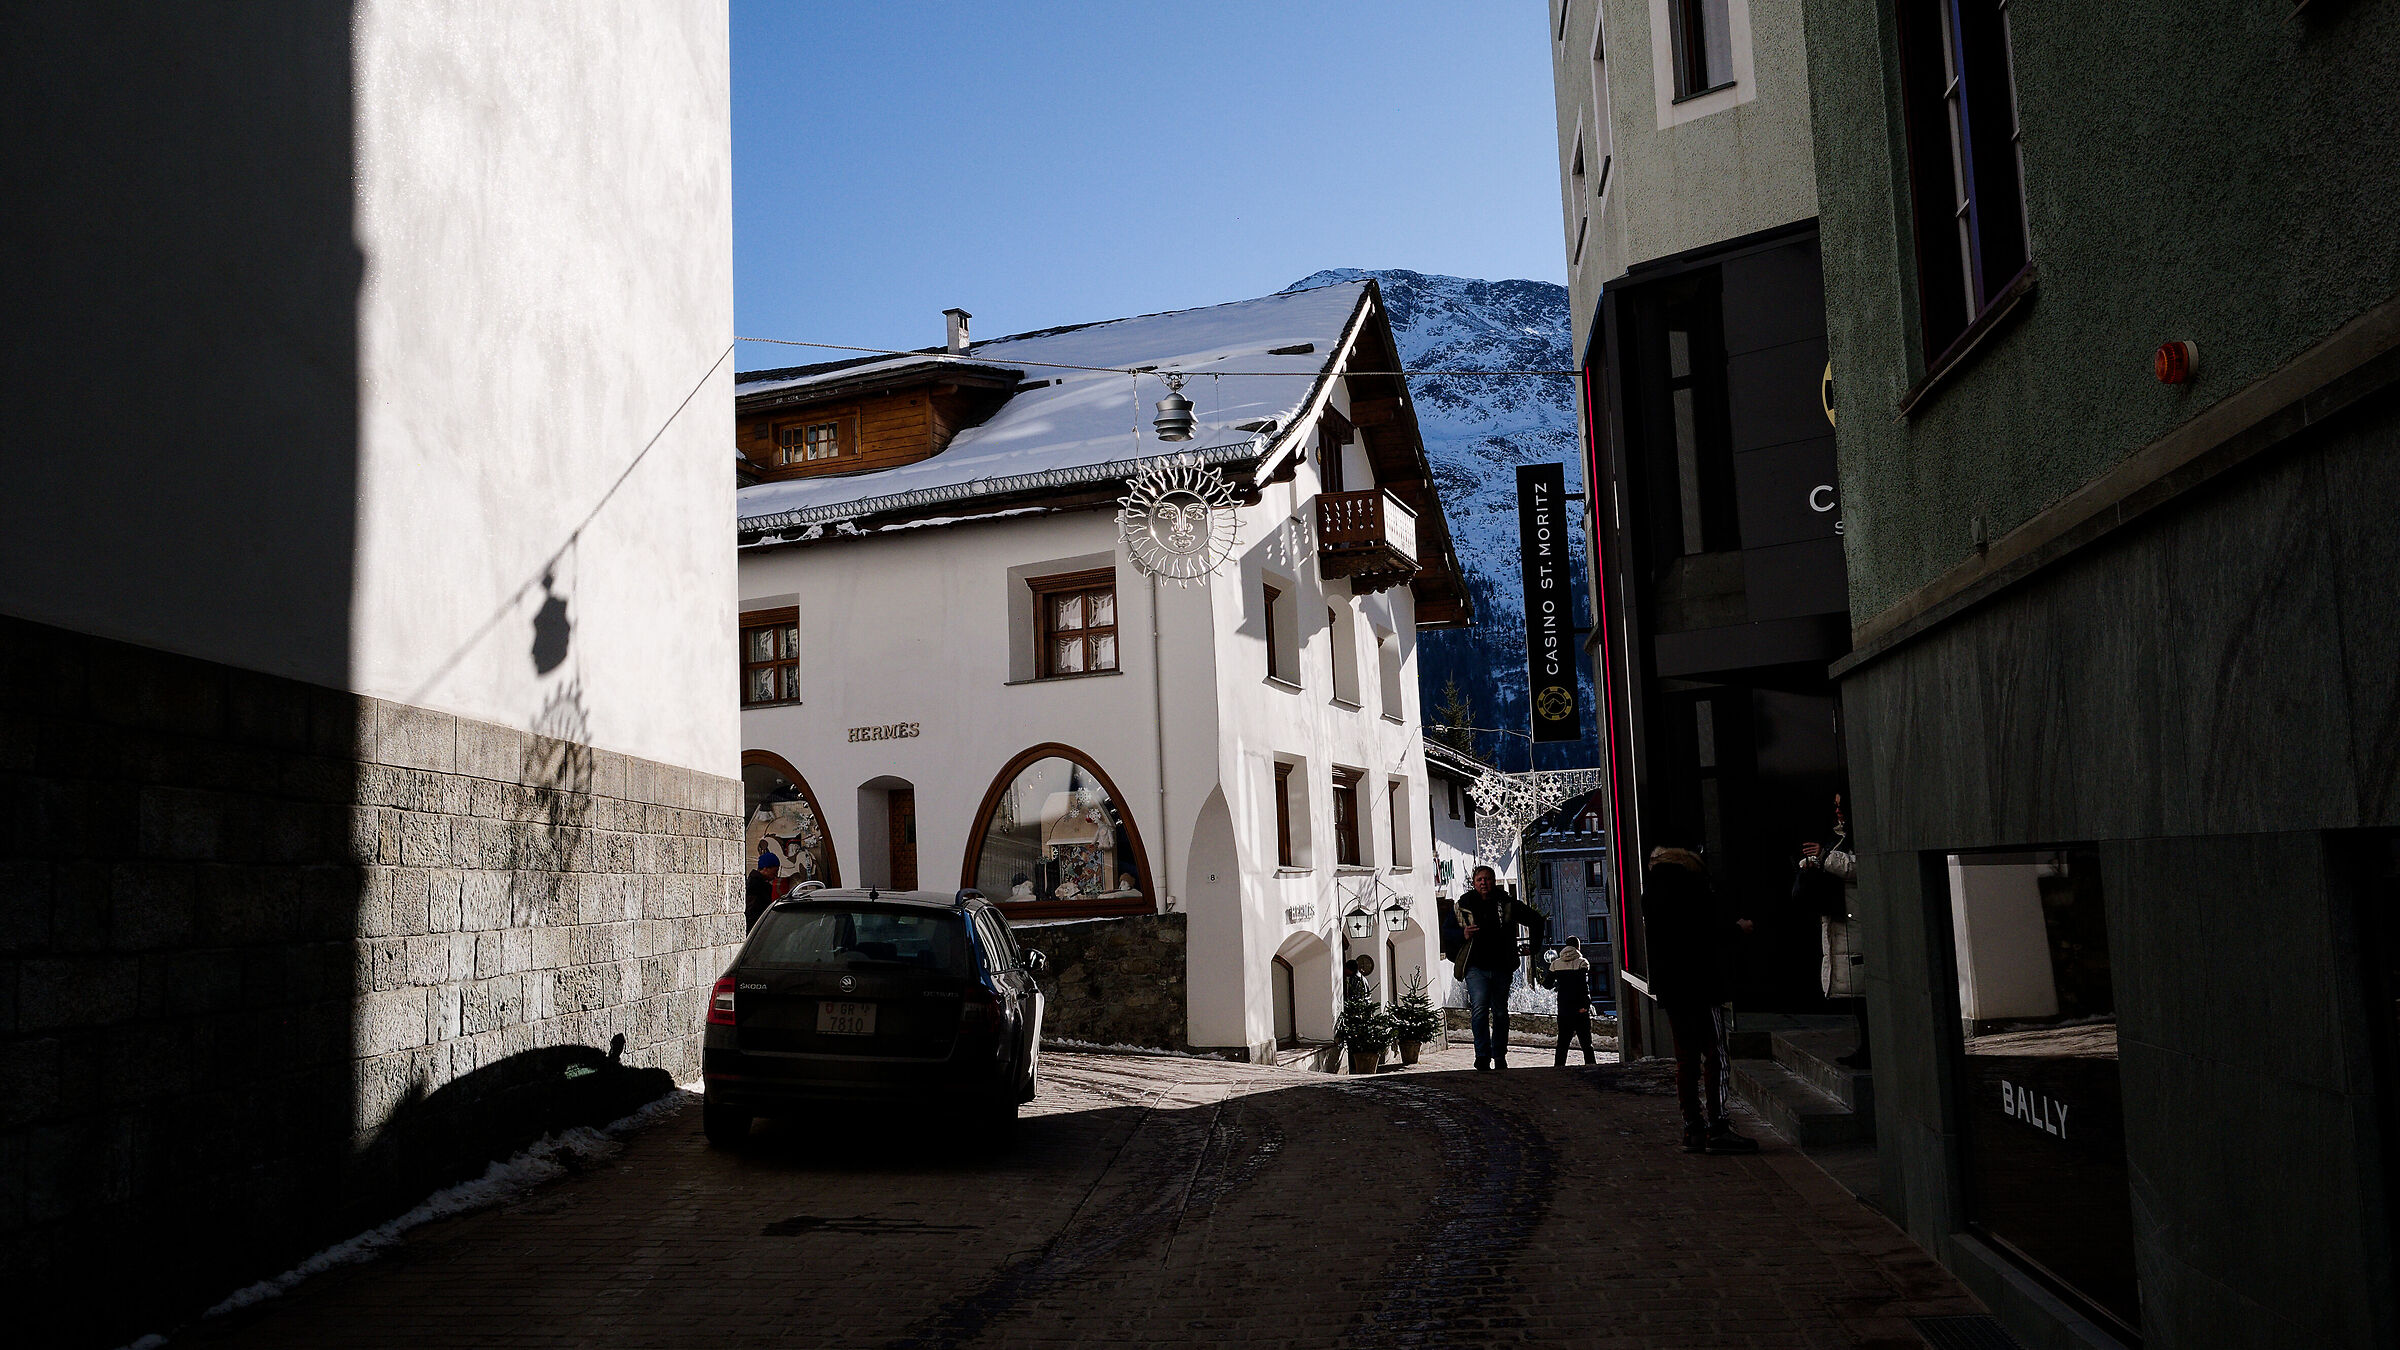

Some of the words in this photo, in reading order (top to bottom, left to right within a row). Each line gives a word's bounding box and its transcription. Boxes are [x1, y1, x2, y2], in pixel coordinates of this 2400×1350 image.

[1535, 482, 1552, 556] MORITZ
[1540, 561, 1554, 589] ST.
[1542, 600, 1559, 675] CASINO
[830, 1016, 864, 1032] 7810
[840, 1003, 855, 1015] GR
[2001, 1079, 2068, 1140] BALLY
